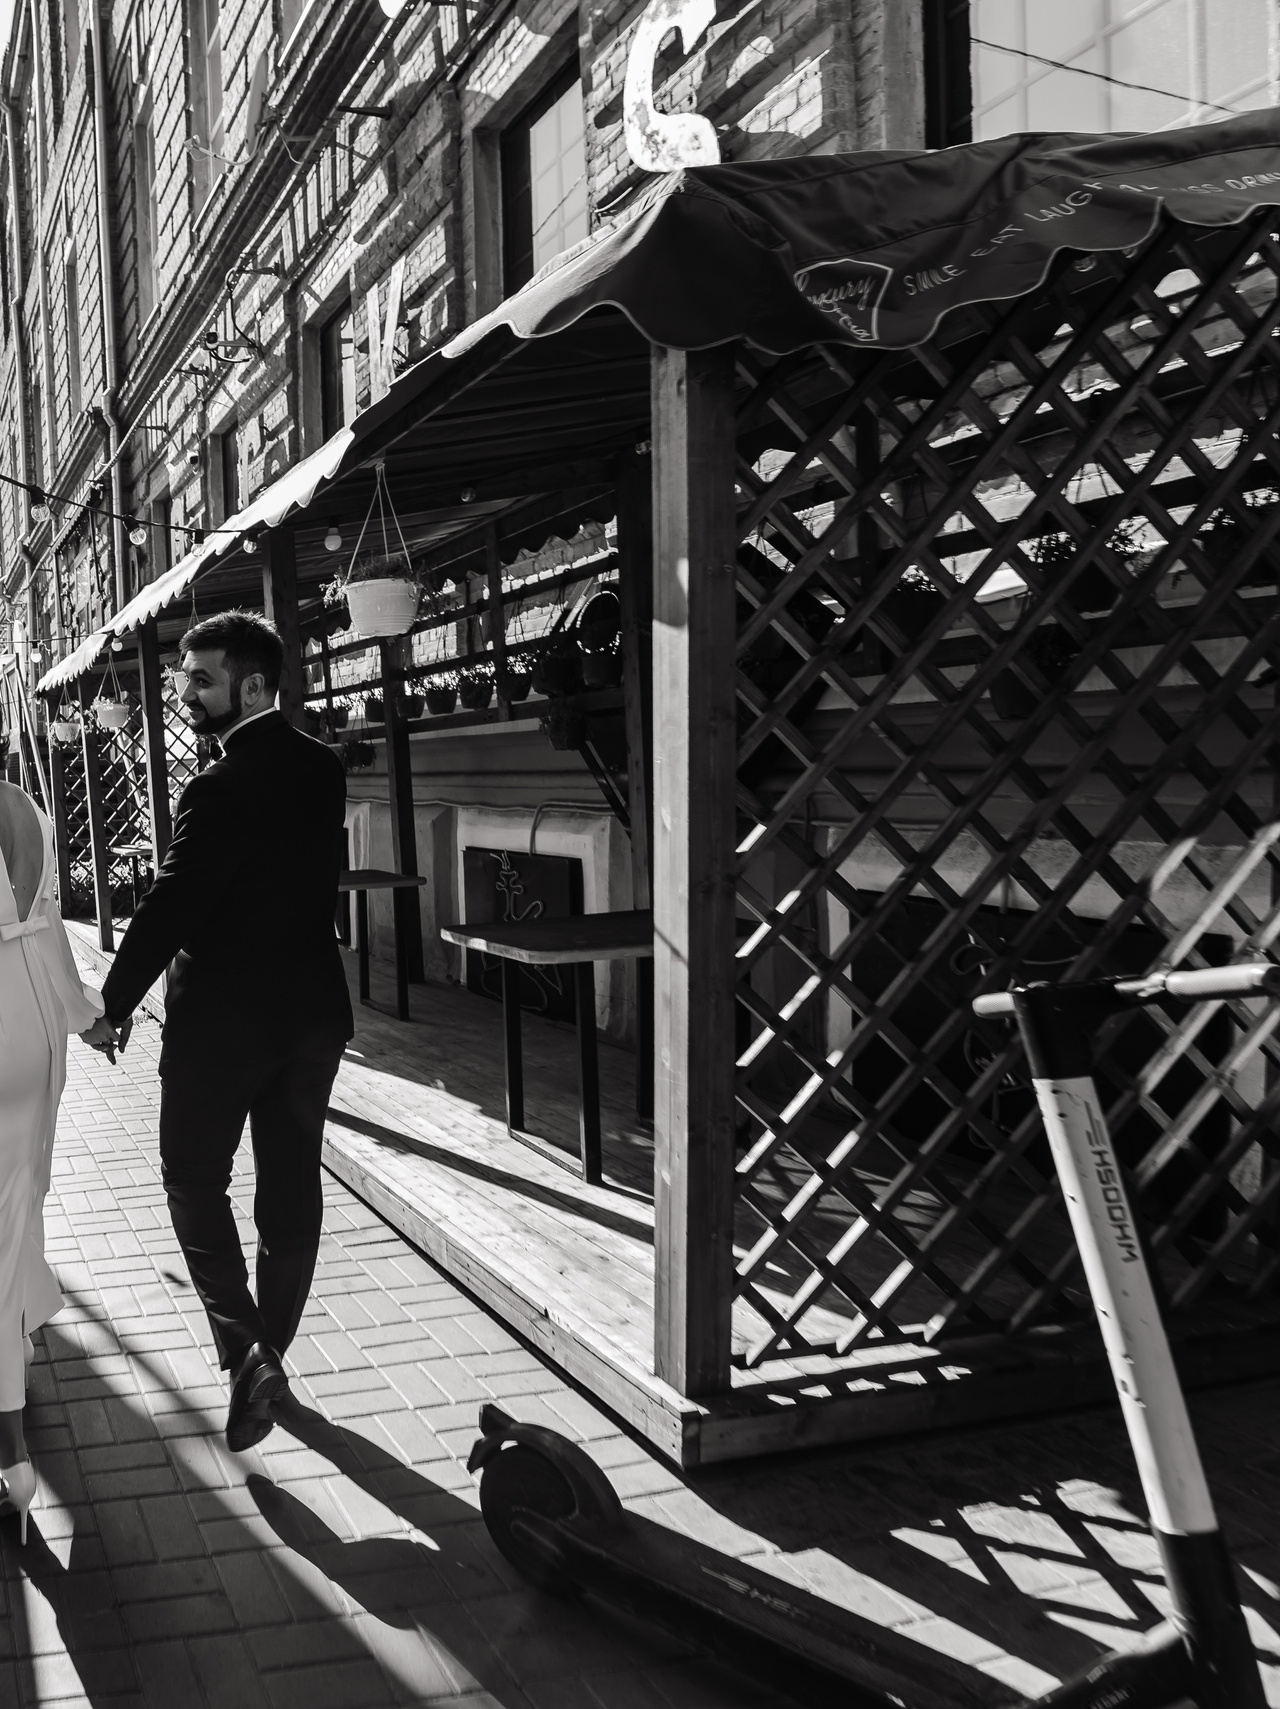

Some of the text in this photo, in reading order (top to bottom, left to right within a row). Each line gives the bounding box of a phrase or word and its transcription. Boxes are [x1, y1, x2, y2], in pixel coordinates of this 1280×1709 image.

[903, 264, 968, 296] SMILE
[970, 223, 1024, 257] EAT
[1090, 1148, 1140, 1264] WHOOSH
